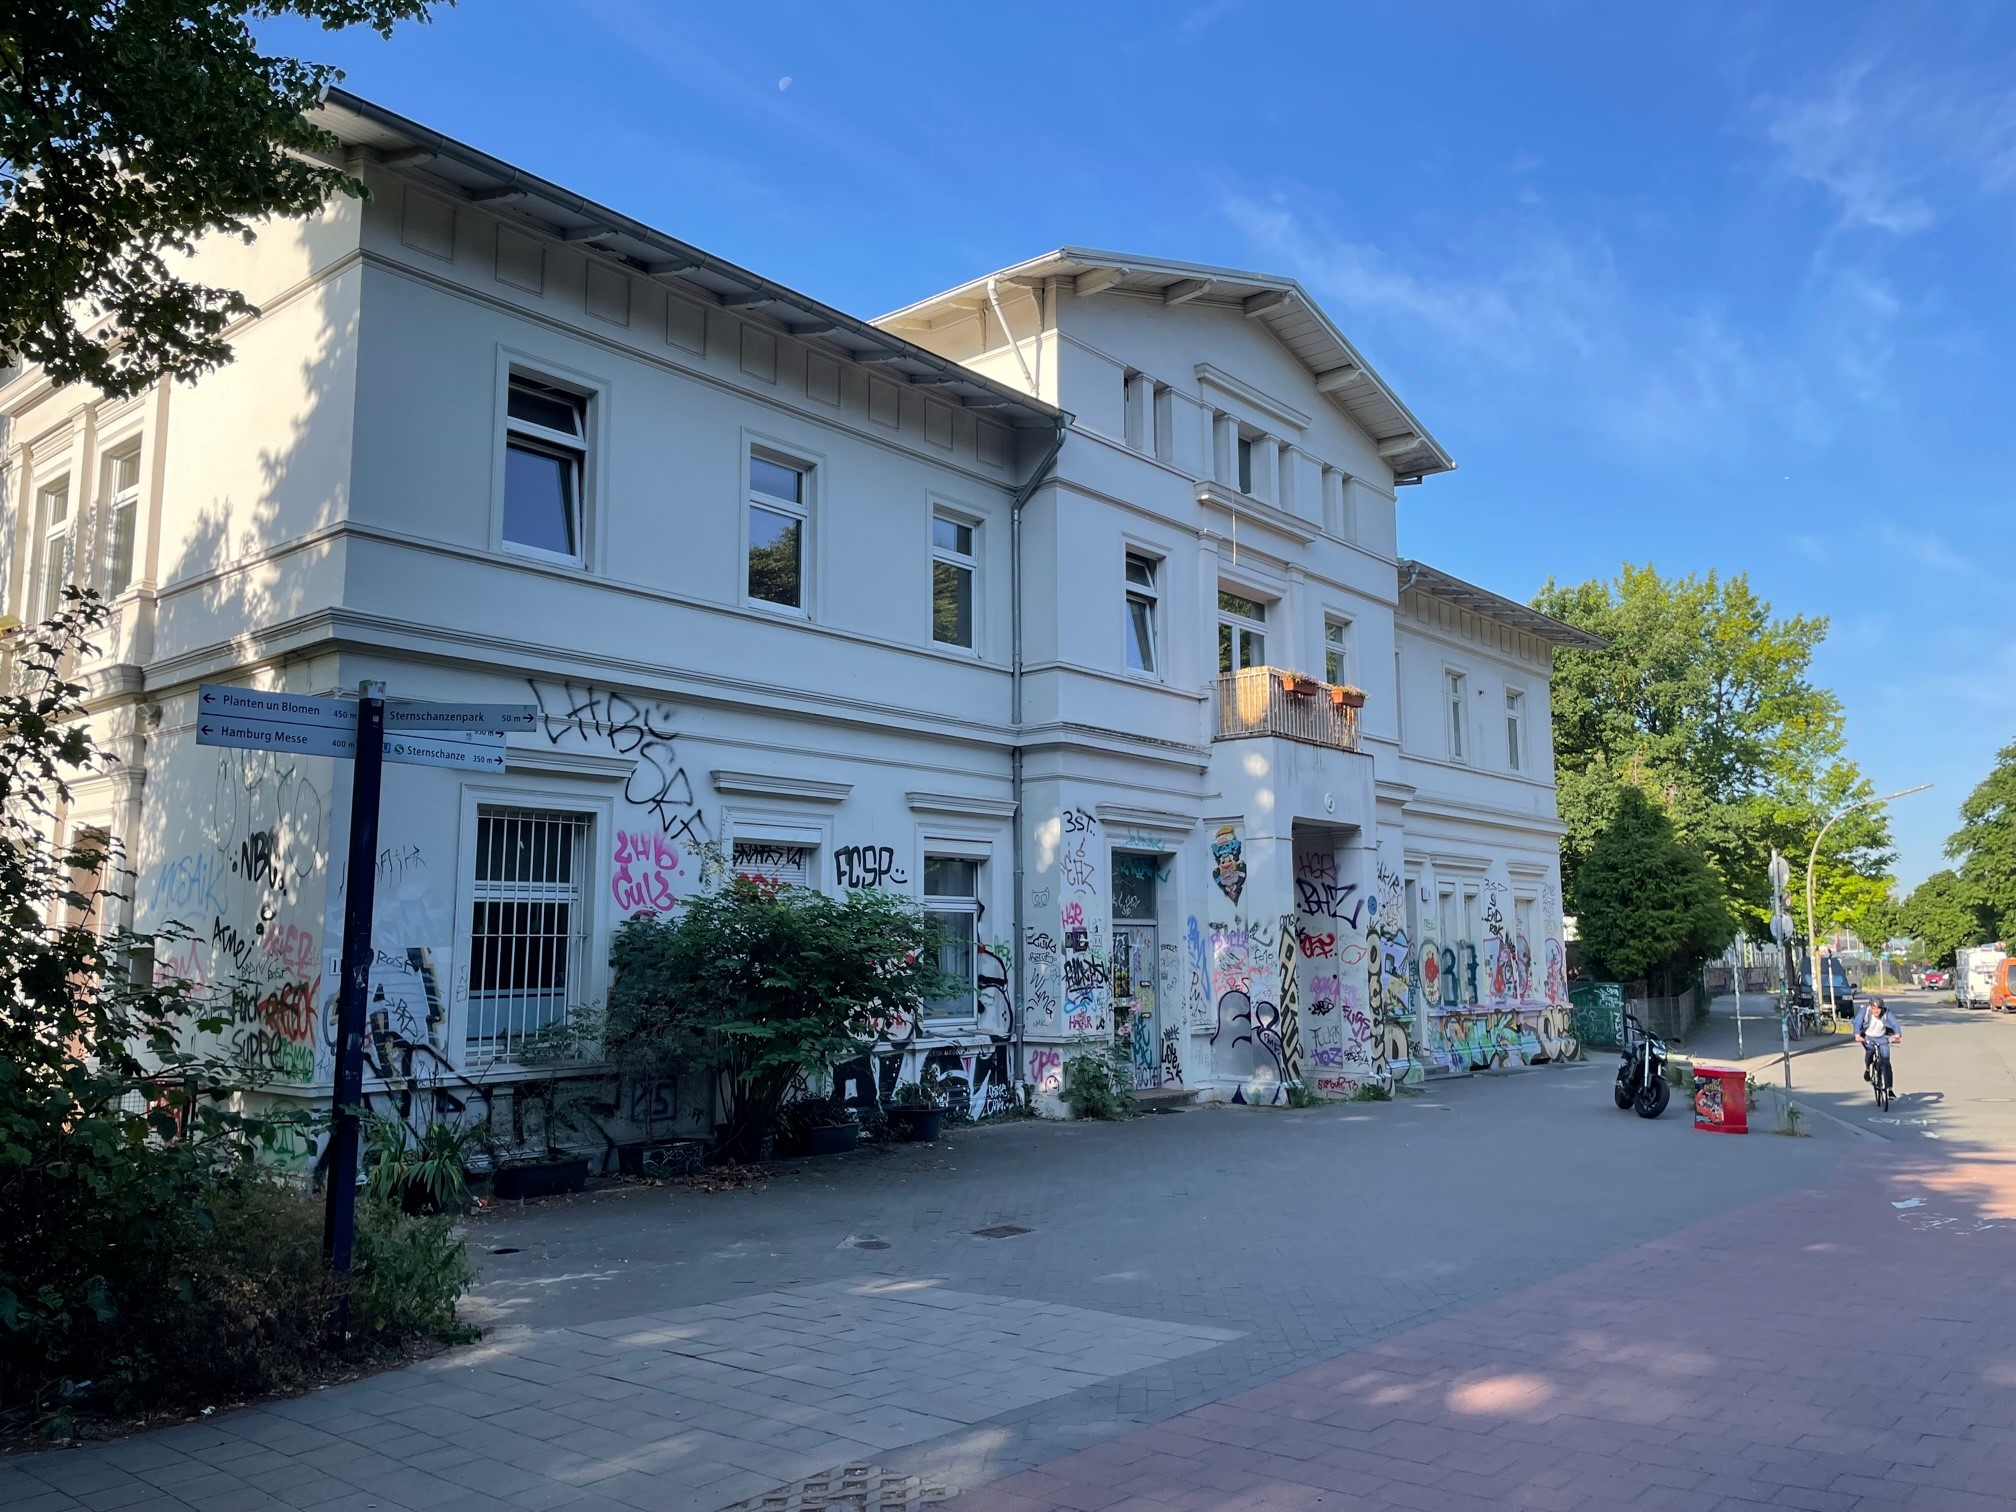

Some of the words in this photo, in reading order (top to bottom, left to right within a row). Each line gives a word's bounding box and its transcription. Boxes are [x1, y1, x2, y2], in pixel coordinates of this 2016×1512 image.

[223, 694, 263, 710] Planten
[266, 702, 279, 711] un
[281, 699, 320, 716] Blomen
[333, 710, 348, 719] 450
[389, 711, 485, 723] Sternschanzenpark
[501, 714, 512, 722] 50
[221, 726, 272, 743] Hamburg
[274, 731, 308, 744] Messe
[332, 739, 346, 748] 400
[407, 745, 466, 762] Sternschanze
[473, 755, 485, 764] 350
